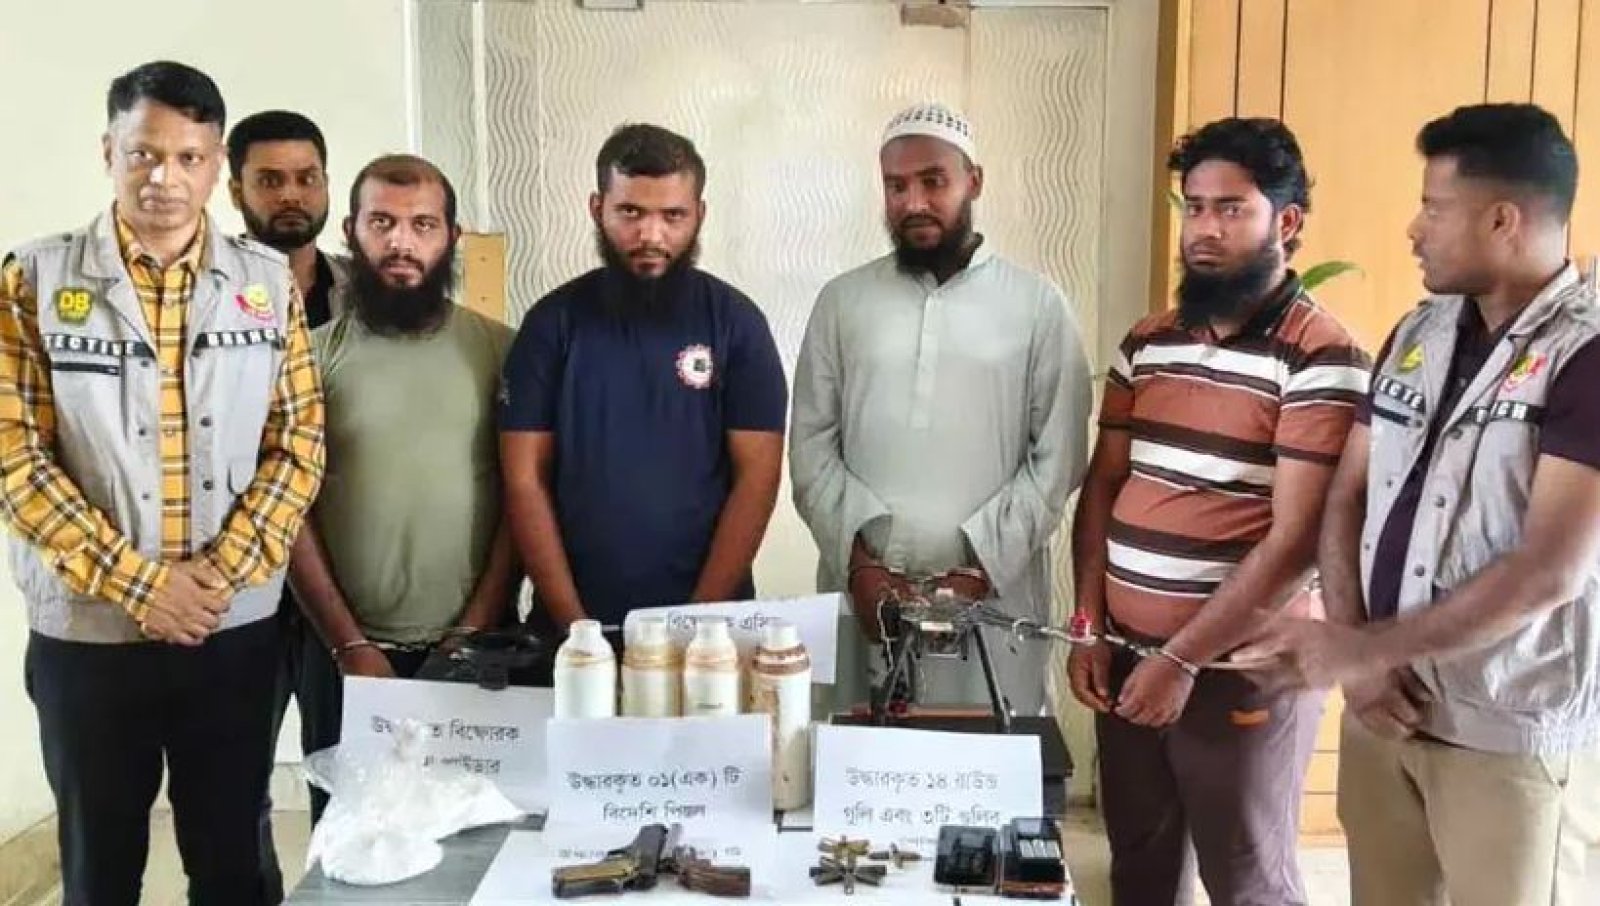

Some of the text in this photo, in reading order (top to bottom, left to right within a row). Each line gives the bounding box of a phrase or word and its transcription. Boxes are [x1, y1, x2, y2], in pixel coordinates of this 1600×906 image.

[566, 771, 642, 793] উদ্ধারকৃত
[723, 765, 743, 785] টি
[846, 767, 921, 793] উদ্ধারকৃত
